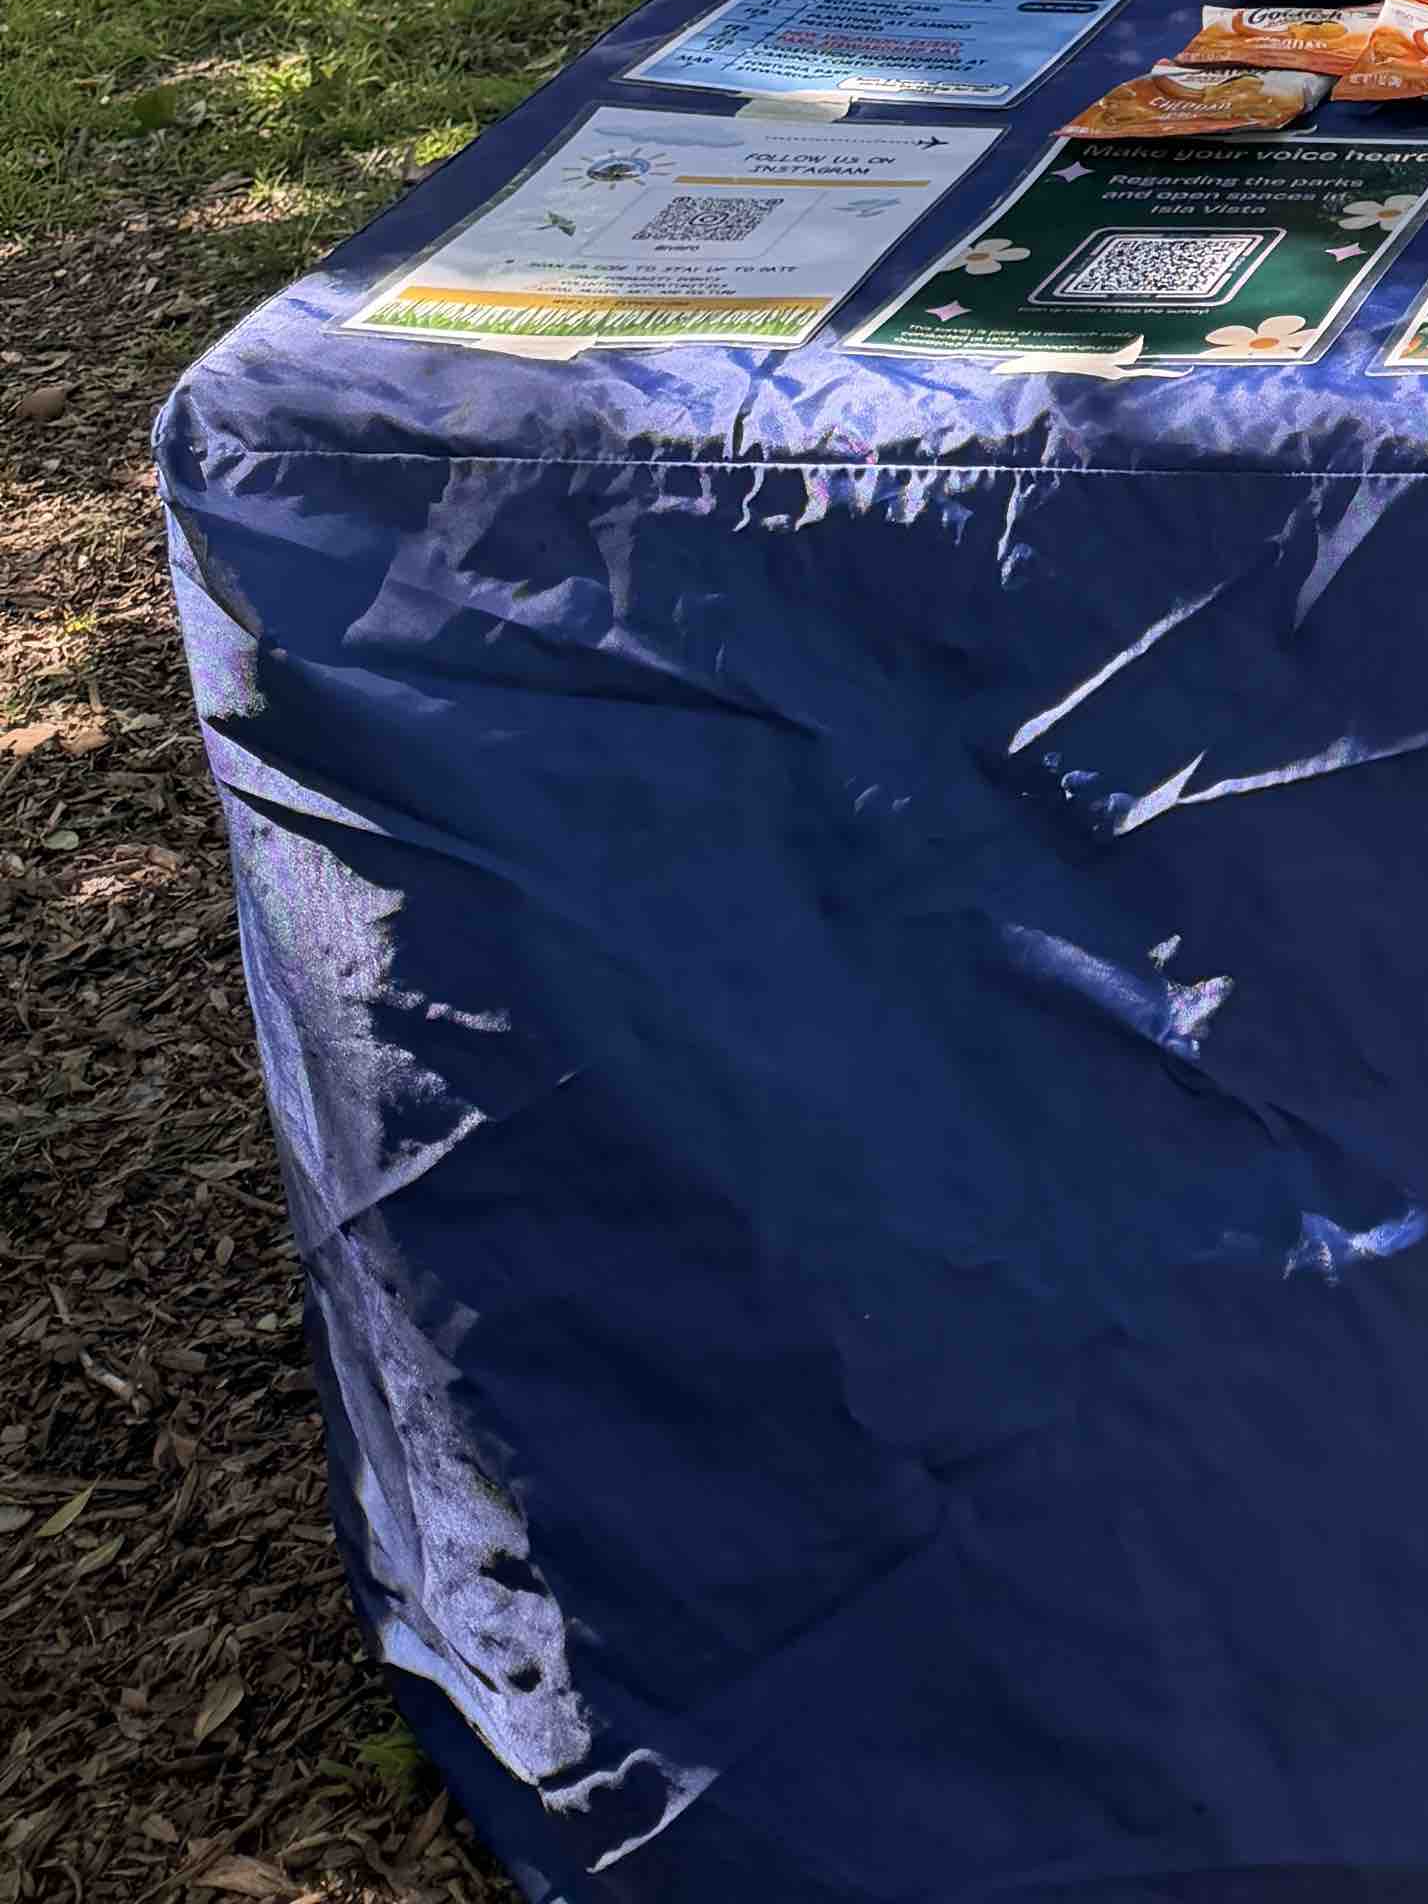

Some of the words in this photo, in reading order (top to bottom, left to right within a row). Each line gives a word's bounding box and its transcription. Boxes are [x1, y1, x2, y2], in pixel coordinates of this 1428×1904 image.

[745, 152, 828, 164] FOLLOW
[832, 156, 861, 165] US
[867, 156, 896, 165] ON
[1083, 144, 1168, 159] Make
[1172, 148, 1249, 162] your
[1256, 149, 1338, 162] voice
[747, 165, 872, 176] INSTAGRAM
[1108, 174, 1238, 189] Regarding
[1247, 175, 1285, 188] the
[1289, 175, 1364, 190] parks
[1101, 191, 1152, 200] and
[1155, 192, 1221, 203] open
[1225, 192, 1316, 203] spaces
[1150, 203, 1197, 214] Isla
[1205, 204, 1268, 215] Vista
